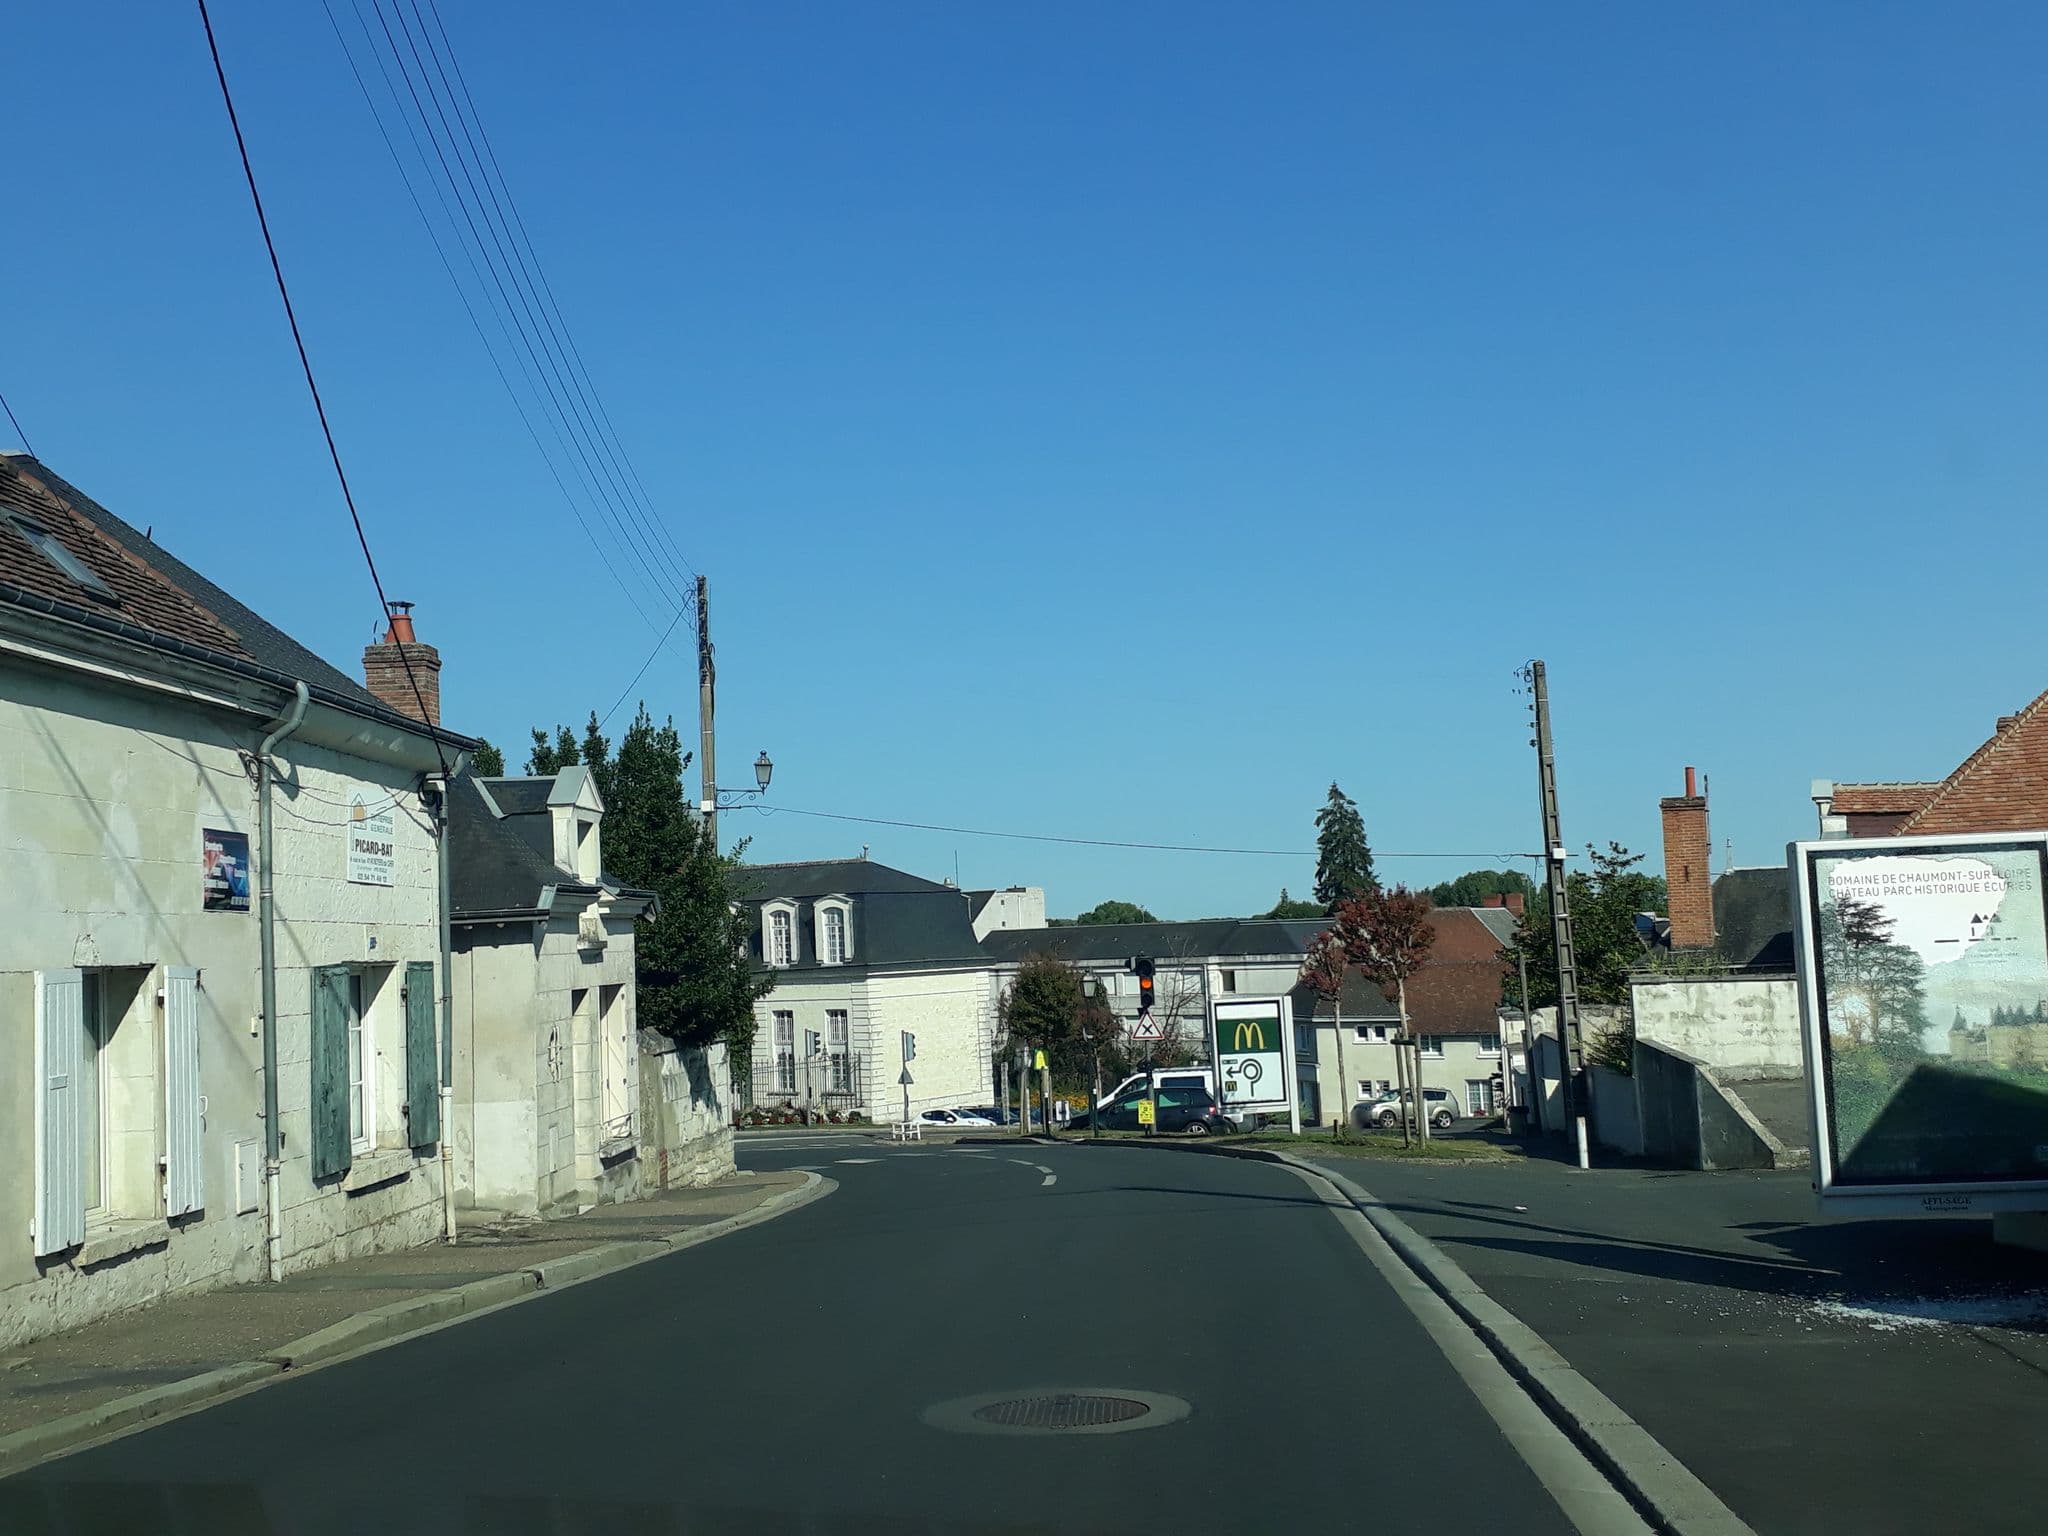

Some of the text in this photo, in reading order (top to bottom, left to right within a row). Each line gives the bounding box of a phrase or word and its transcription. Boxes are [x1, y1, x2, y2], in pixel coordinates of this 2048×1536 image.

[355, 838, 394, 857] PICARD-BAT
[1828, 873, 1880, 886] DOMAINE
[1882, 873, 1897, 884] DE
[1829, 881, 2032, 899] CHÂTEAU PARC HISTORIQUE ÉCURIES
